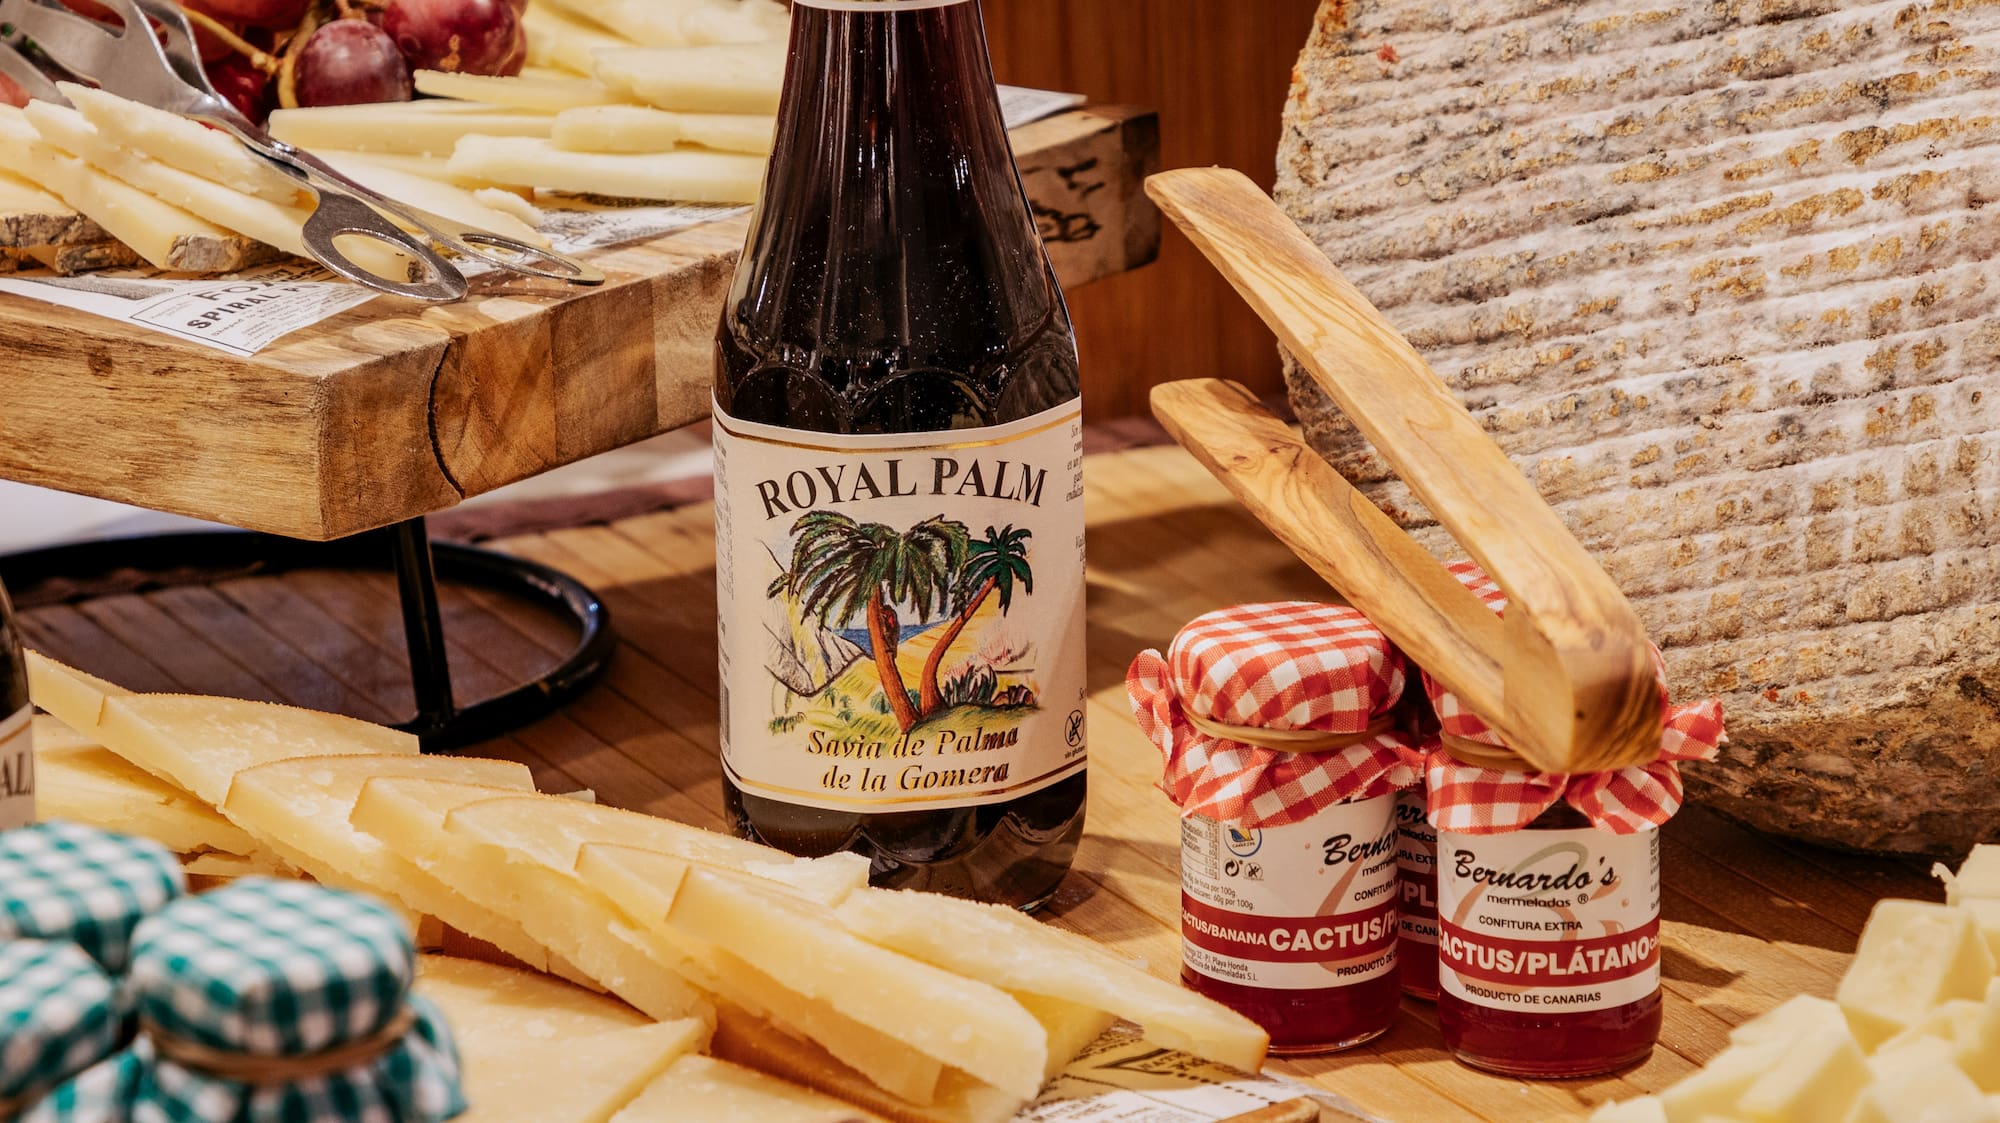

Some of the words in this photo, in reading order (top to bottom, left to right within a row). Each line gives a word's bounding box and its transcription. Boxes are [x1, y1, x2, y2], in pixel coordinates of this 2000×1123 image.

[186, 294, 281, 330] SPIRAL
[754, 457, 918, 521] ROYAL
[928, 456, 1048, 508] PALM
[806, 729, 882, 761] Savia
[891, 731, 926, 759] de
[934, 726, 1020, 756] Palma
[819, 764, 852, 790] de
[858, 766, 887, 793] la
[896, 762, 1010, 792] Gomera
[1454, 849, 1618, 892] Bernardo's
[1487, 893, 1571, 909] mermeladas
[1402, 920, 1413, 932] DE
[1479, 915, 1541, 931] CONFITURA
[1544, 920, 1583, 931] EXTRA
[1337, 956, 1385, 977] PRODUCTO
[1465, 983, 1521, 1003] PRODUCTO
[1524, 995, 1540, 1004] DE
[1543, 991, 1602, 1005] CANARIAS
